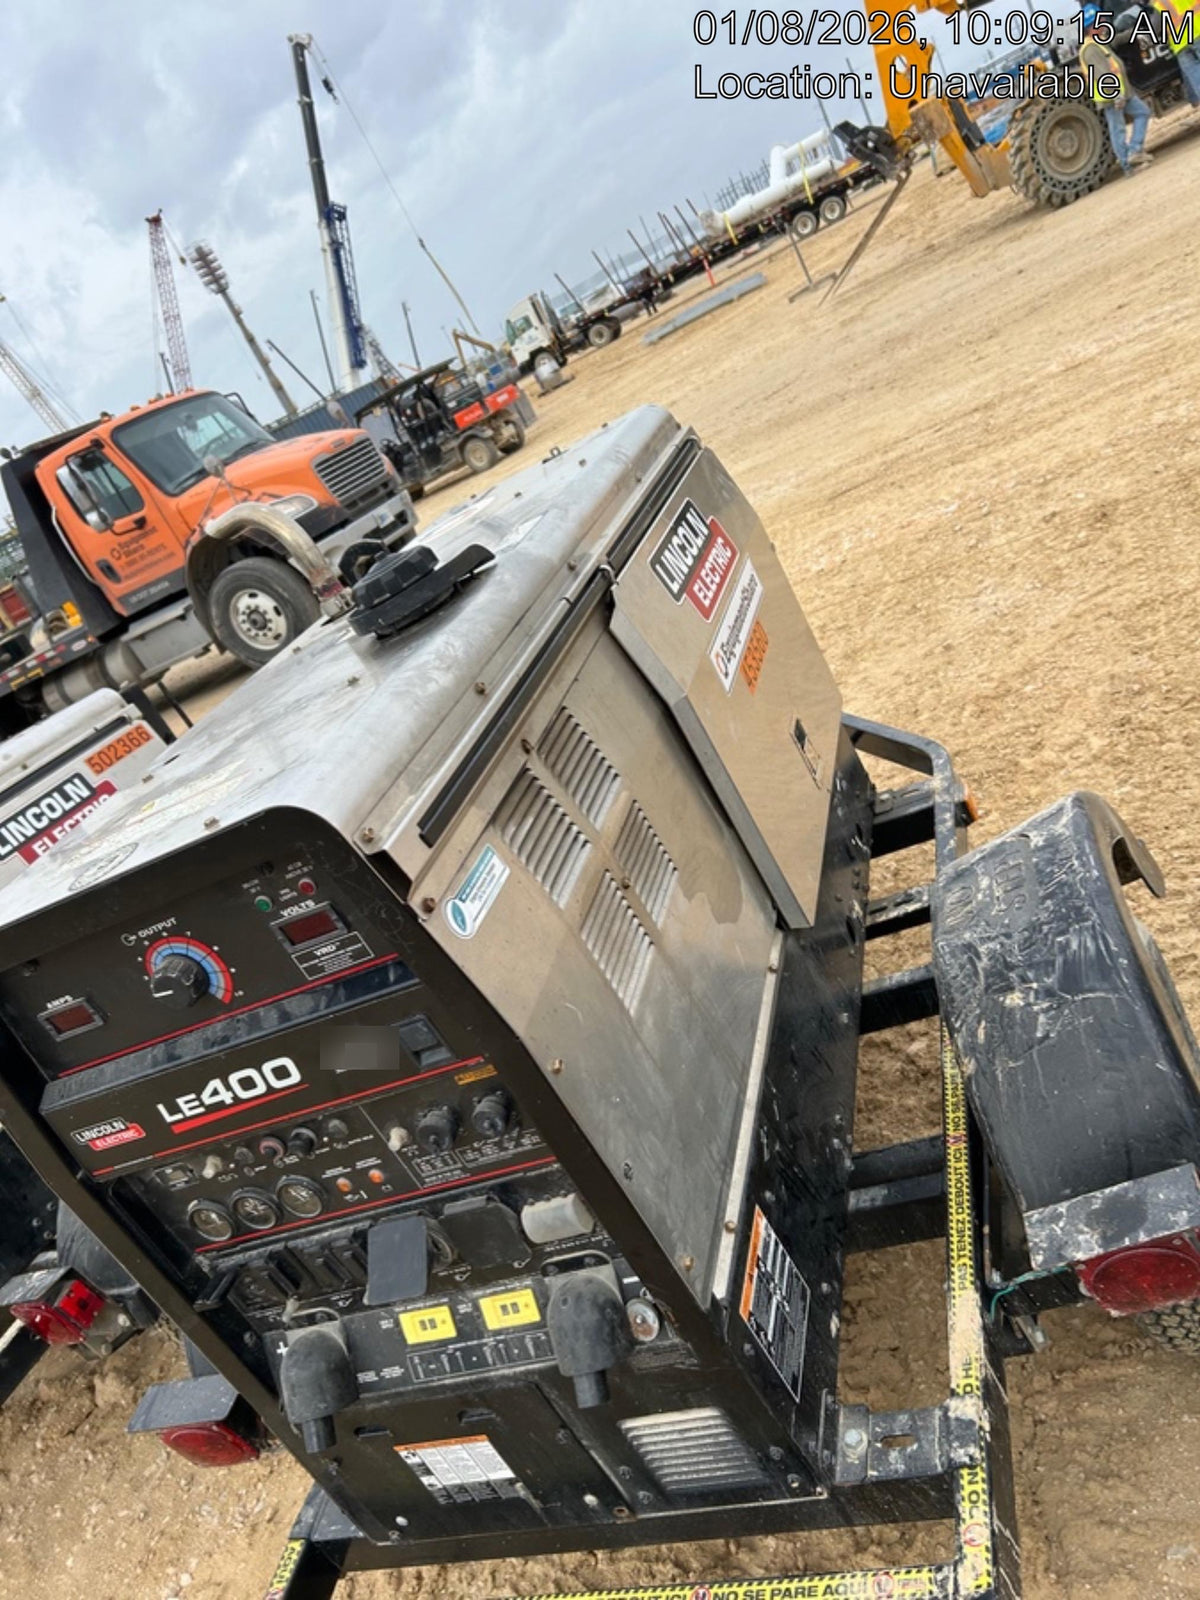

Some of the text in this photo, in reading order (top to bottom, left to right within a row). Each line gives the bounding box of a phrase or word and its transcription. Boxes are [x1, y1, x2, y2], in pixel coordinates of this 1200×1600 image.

[655, 507, 709, 594] LINCOLN
[692, 537, 732, 608] ELECTRIC
[86, 724, 154, 774] 502366
[280, 899, 316, 918] VOLTS
[138, 917, 177, 938] OUTPUT
[156, 1056, 302, 1124] LE400
[75, 1119, 126, 1142] LINCOLN
[951, 1115, 962, 1132] NO
[95, 1127, 139, 1149] ELECTRIC
[952, 1147, 969, 1292] PAS TENEZ DEBOUT ICI
[742, 1588, 767, 1600] SE
[769, 1585, 818, 1600] PARE
